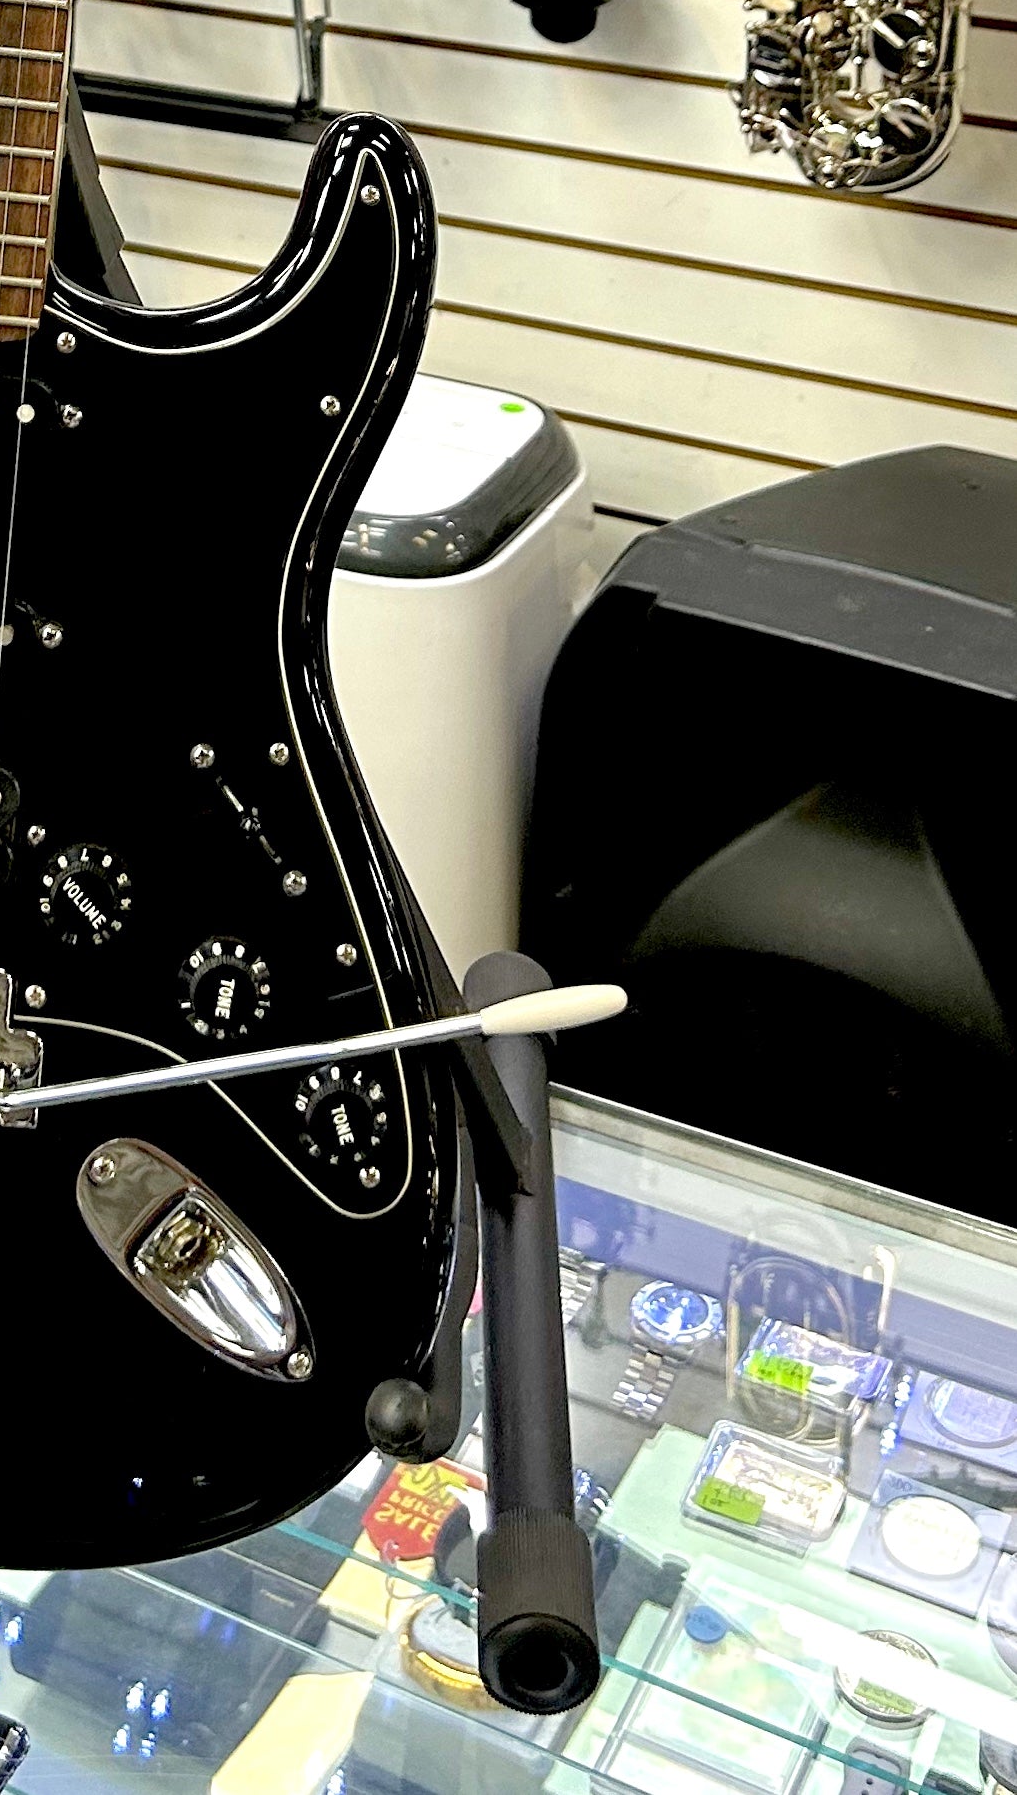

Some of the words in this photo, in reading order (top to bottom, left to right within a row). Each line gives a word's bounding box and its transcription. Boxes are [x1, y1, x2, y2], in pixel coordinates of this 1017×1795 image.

[62, 876, 107, 930] VOLUME
[214, 978, 236, 1020] TONE
[330, 1103, 355, 1146] TONE
